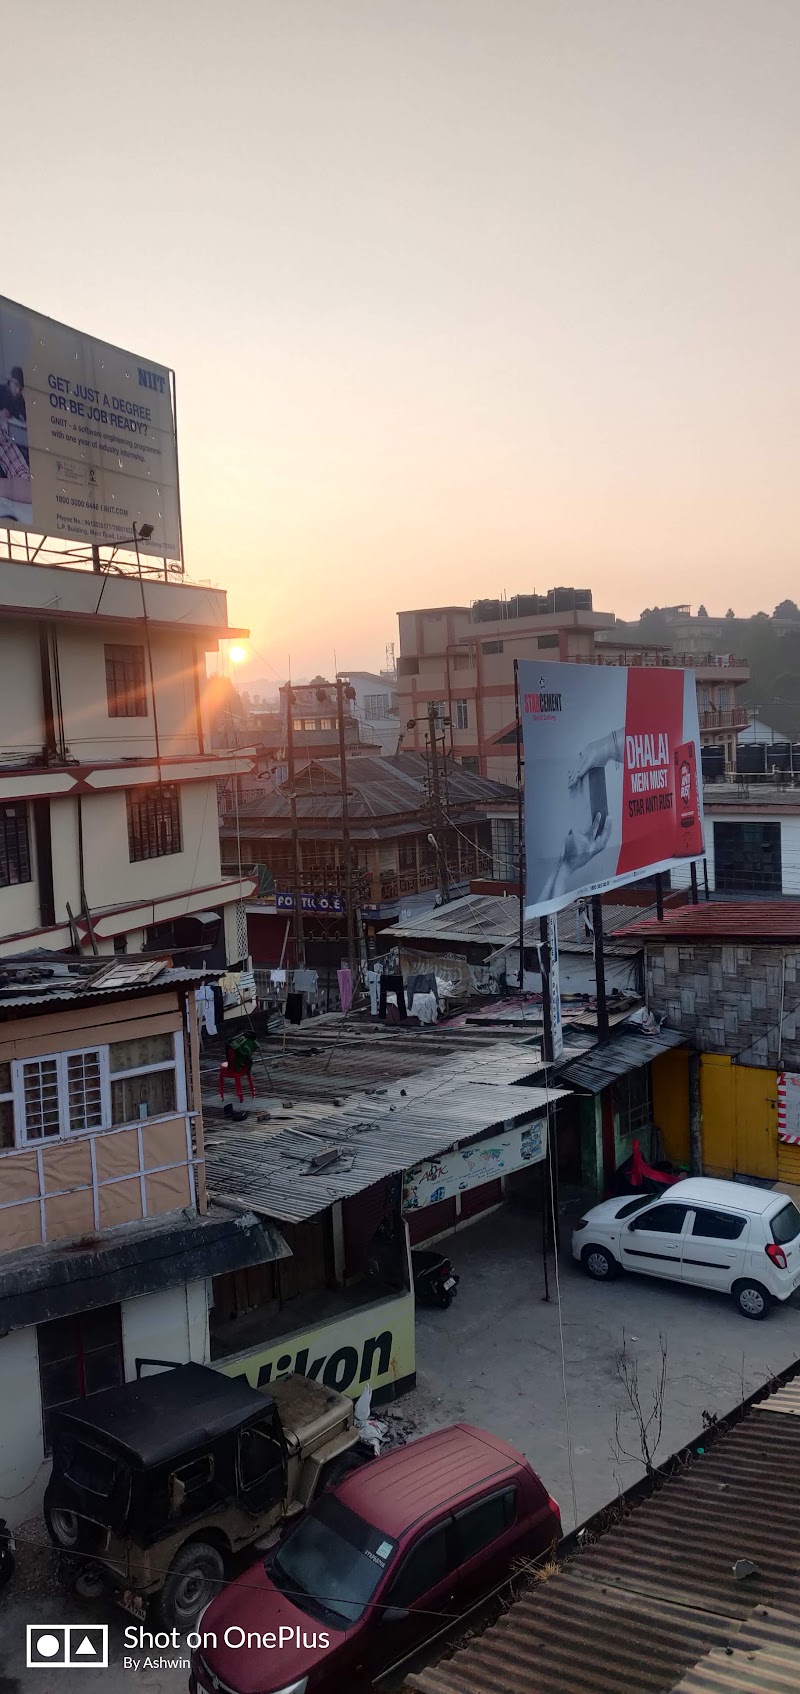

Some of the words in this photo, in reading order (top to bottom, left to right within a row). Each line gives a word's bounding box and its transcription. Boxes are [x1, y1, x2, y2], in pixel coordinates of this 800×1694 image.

[137, 368, 165, 394] NIIT
[48, 374, 70, 394] GET
[74, 384, 100, 404] JUST
[103, 394, 110, 408] A
[112, 396, 152, 421] DEGREE
[50, 393, 67, 411] OR
[70, 400, 84, 416] BE
[87, 408, 108, 424] JOB
[110, 413, 148, 436] READY?
[50, 416, 67, 428] GNIIT
[78, 424, 102, 438] software
[103, 433, 133, 448] engineering
[51, 430, 64, 439] with
[66, 434, 77, 442] one
[77, 437, 90, 446] year
[91, 440, 98, 449] of
[98, 442, 120, 456] industry
[56, 514, 72, 523] Phone
[626, 733, 669, 769] DHALAI
[631, 772, 650, 793] MEIN
[650, 768, 667, 790] MUST
[628, 798, 644, 817] STAR
[645, 795, 658, 814] ANTI
[658, 793, 673, 810] RUST
